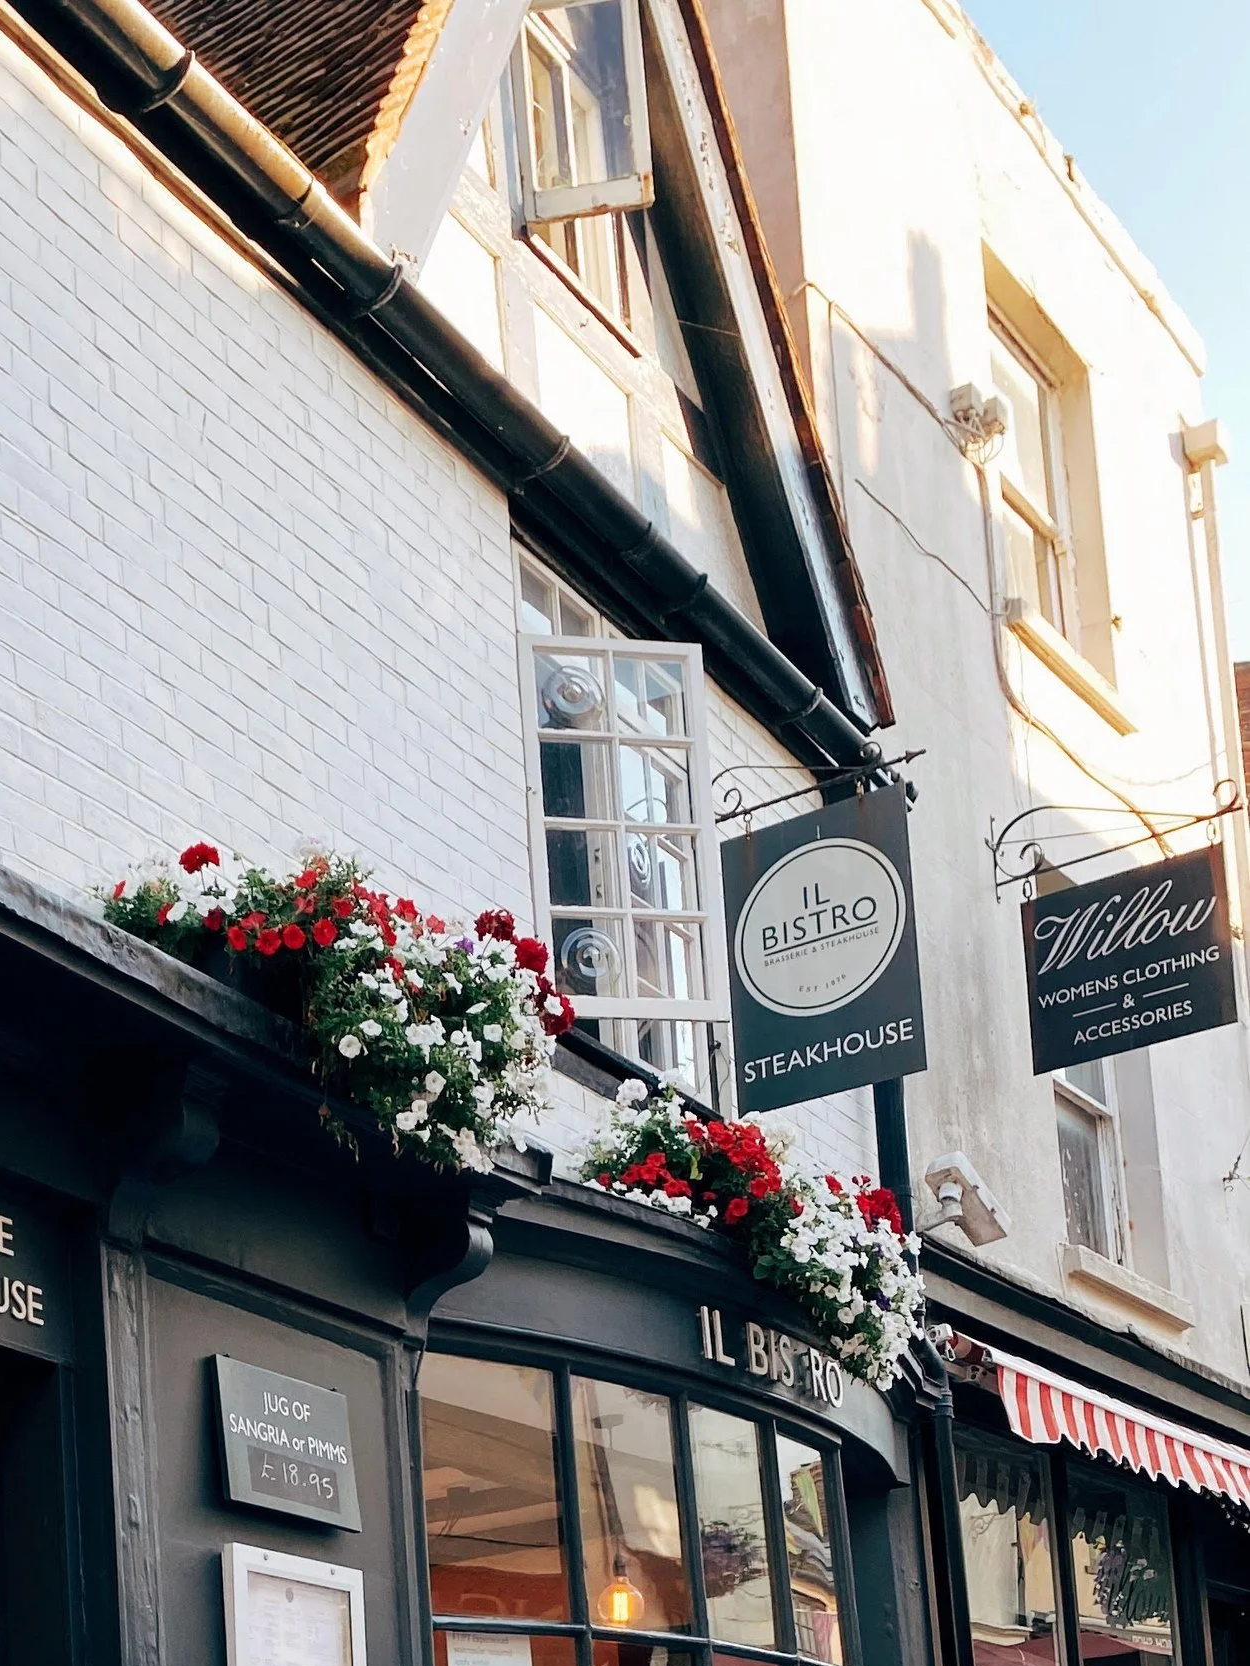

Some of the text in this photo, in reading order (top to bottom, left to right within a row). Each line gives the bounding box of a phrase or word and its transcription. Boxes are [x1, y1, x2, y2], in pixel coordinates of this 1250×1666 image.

[803, 883, 830, 909] IL
[762, 896, 877, 951] BISTRO
[764, 949, 808, 967] BRASSERIE
[820, 927, 879, 951] STEAKHOUSE
[1034, 879, 1217, 976] Willow
[1038, 945, 1220, 1009] WOMENS CLOTHING
[1123, 993, 1135, 1009] &
[1074, 1000, 1193, 1045] ACCESSORIES
[744, 1017, 914, 1083] STEAKHOUSE
[699, 1305, 843, 1408] IL BISRO
[263, 1391, 311, 1422] JUG OF
[229, 1413, 348, 1464] SANGRIA or PIMMS
